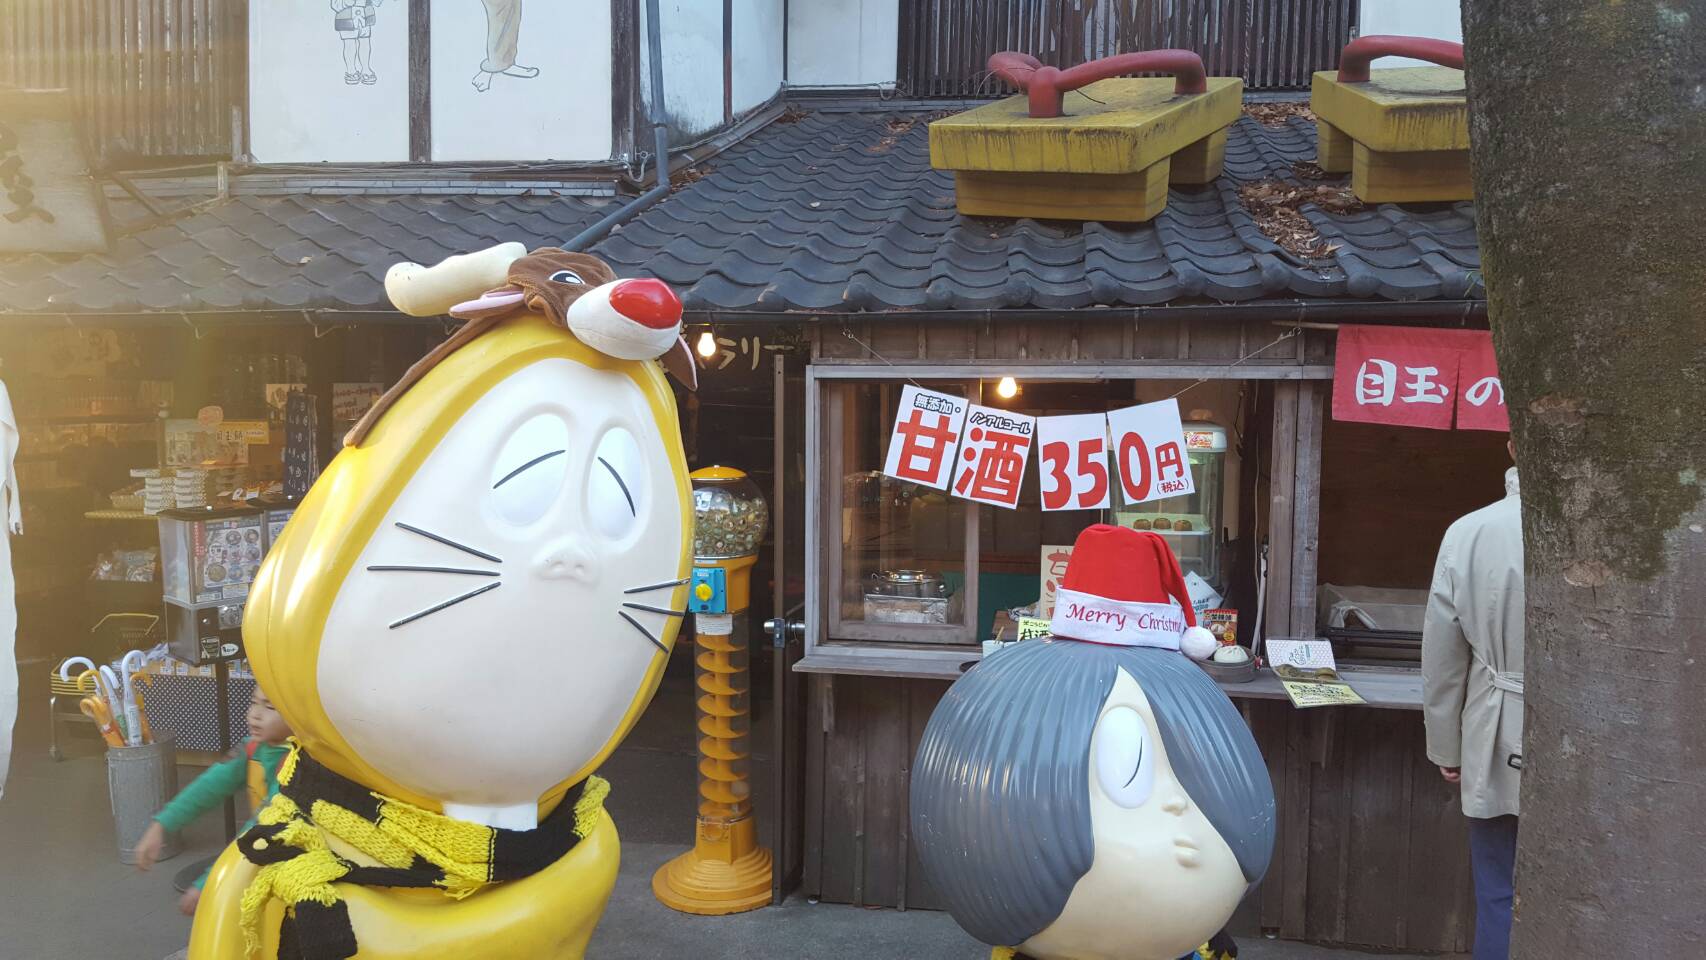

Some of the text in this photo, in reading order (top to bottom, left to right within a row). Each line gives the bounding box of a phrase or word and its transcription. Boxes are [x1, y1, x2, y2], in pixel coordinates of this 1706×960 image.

[681, 320, 796, 371] ラリー
[1355, 358, 1505, 407] 目玉の
[969, 411, 1031, 434] ノンアルコール
[895, 408, 1031, 506] 甘酒
[1065, 603, 1127, 632] Merry
